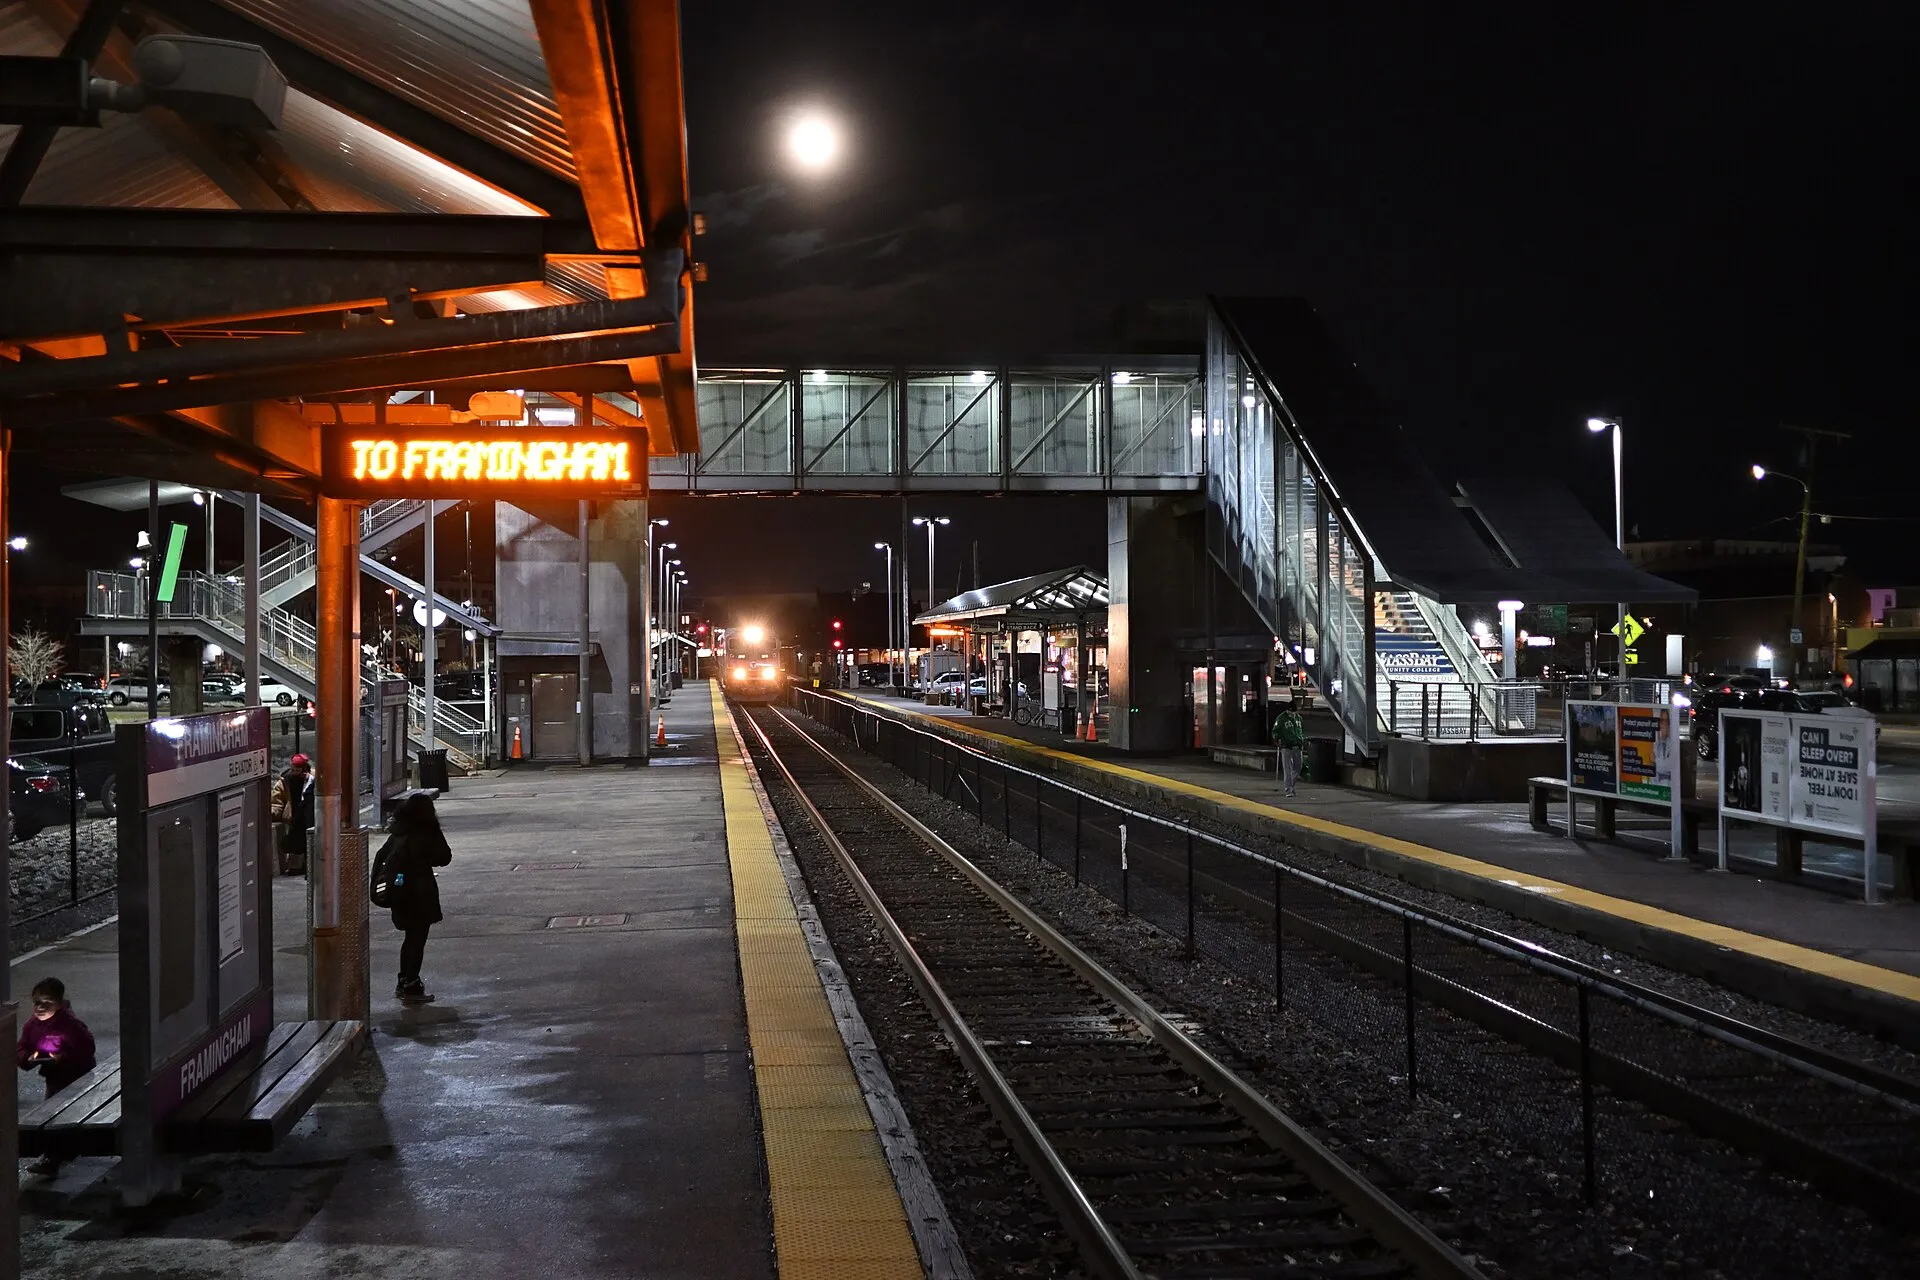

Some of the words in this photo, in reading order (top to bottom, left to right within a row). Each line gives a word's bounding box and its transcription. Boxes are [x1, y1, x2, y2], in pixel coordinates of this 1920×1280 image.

[350, 440, 398, 480] TO
[1801, 731, 1819, 744] CAN
[1820, 733, 1824, 745] I
[1801, 746, 1825, 760] SLEEP
[1826, 749, 1853, 765] OVER?
[229, 757, 252, 778] ELEVATOR
[1800, 766, 1824, 780] HOME
[1825, 769, 1836, 781] AT
[1837, 770, 1858, 784] SAFE
[1807, 782, 1825, 796] FEEL
[1827, 785, 1853, 800] DON'T
[180, 1013, 251, 1100] FRAMINGHAM
